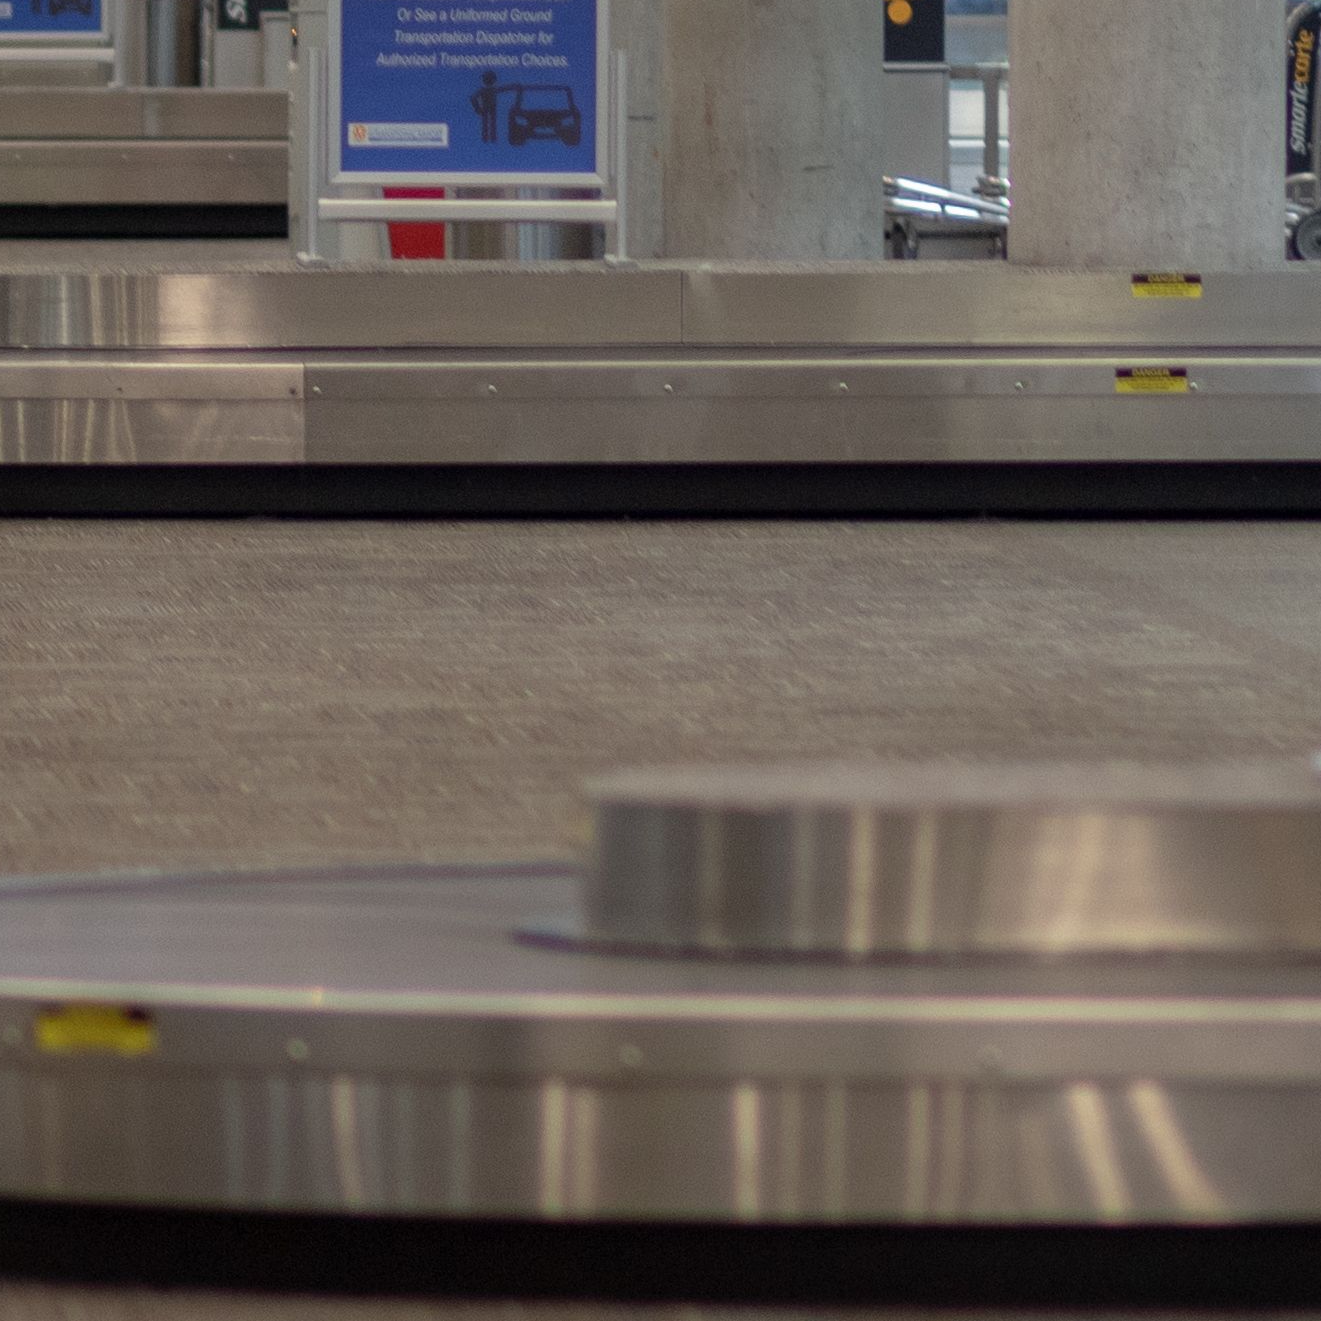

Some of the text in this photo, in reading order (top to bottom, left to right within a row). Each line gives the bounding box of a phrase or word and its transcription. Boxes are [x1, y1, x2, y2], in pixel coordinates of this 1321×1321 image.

[396, 7, 411, 22] Or
[415, 8, 437, 22] See
[439, 10, 448, 22] a
[510, 8, 553, 23] Ground
[395, 29, 555, 47] Transportation Dispatcher for
[376, 52, 437, 67] Authorized
[439, 52, 520, 68] Transportation
[1289, 28, 1315, 155] smartecarte
